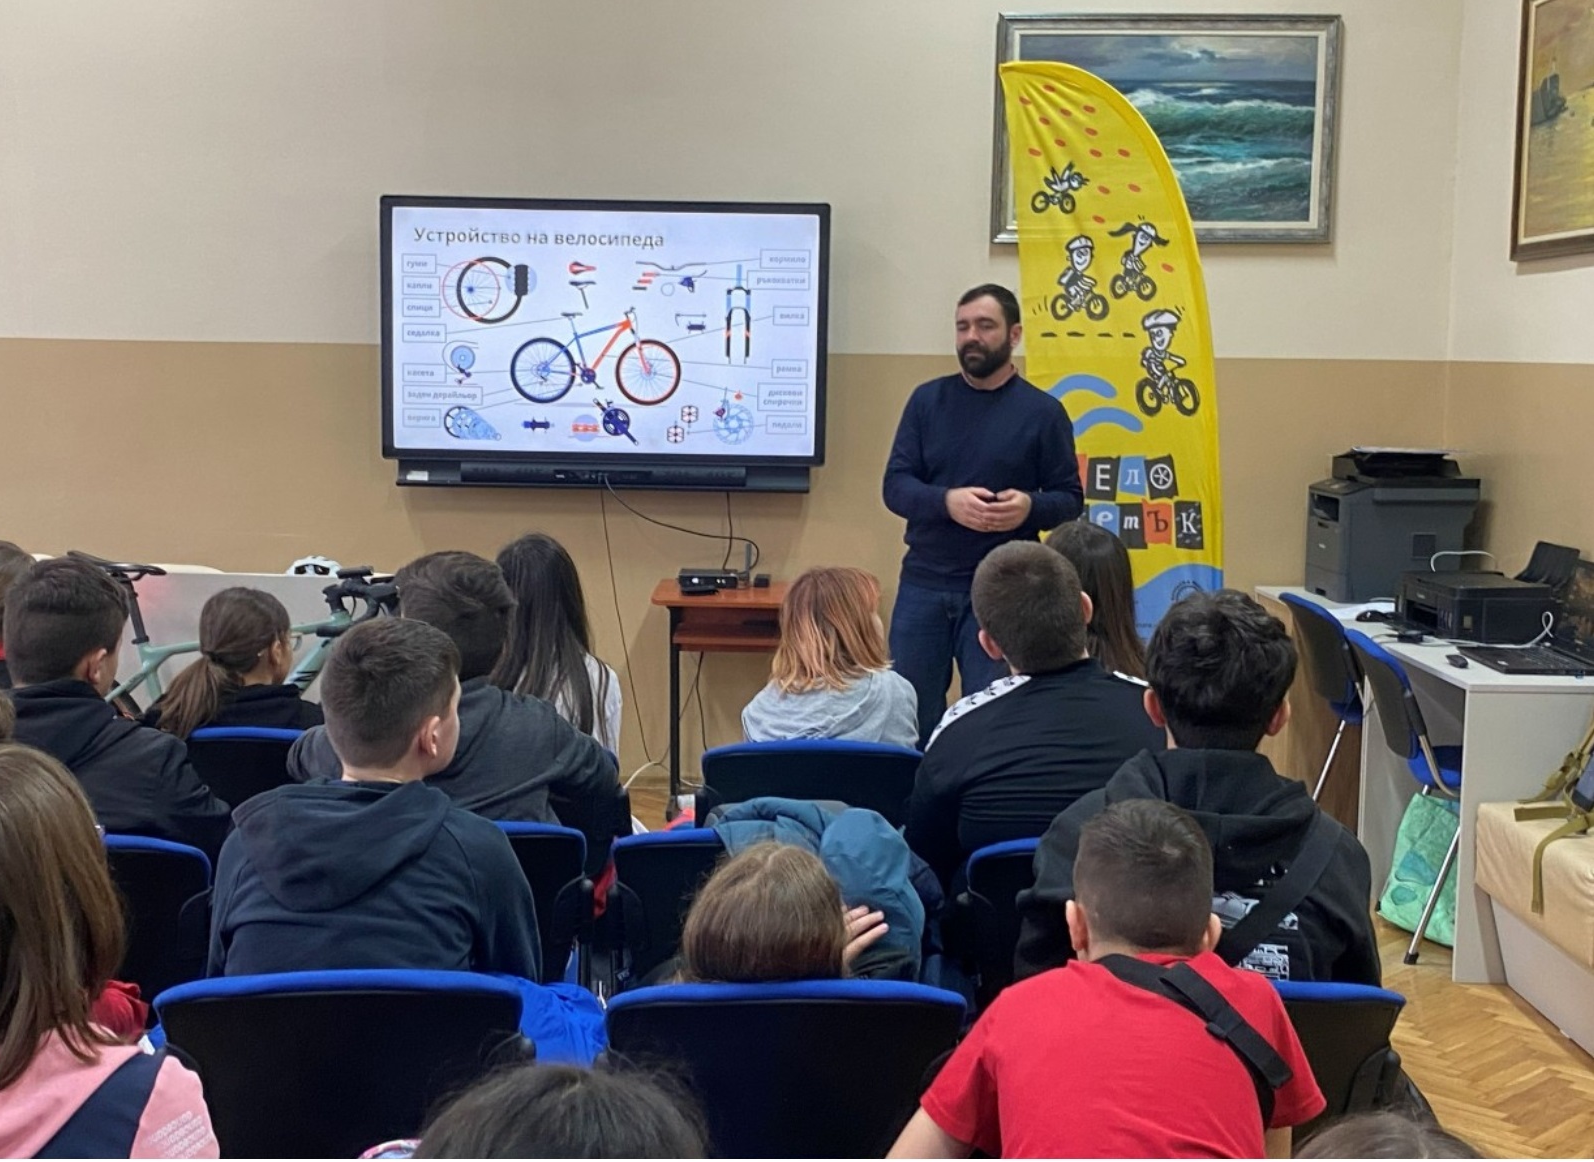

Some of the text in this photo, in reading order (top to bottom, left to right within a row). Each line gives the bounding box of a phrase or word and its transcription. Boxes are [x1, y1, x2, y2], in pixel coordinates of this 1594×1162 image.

[414, 227, 664, 249] Устройство на велосипеда
